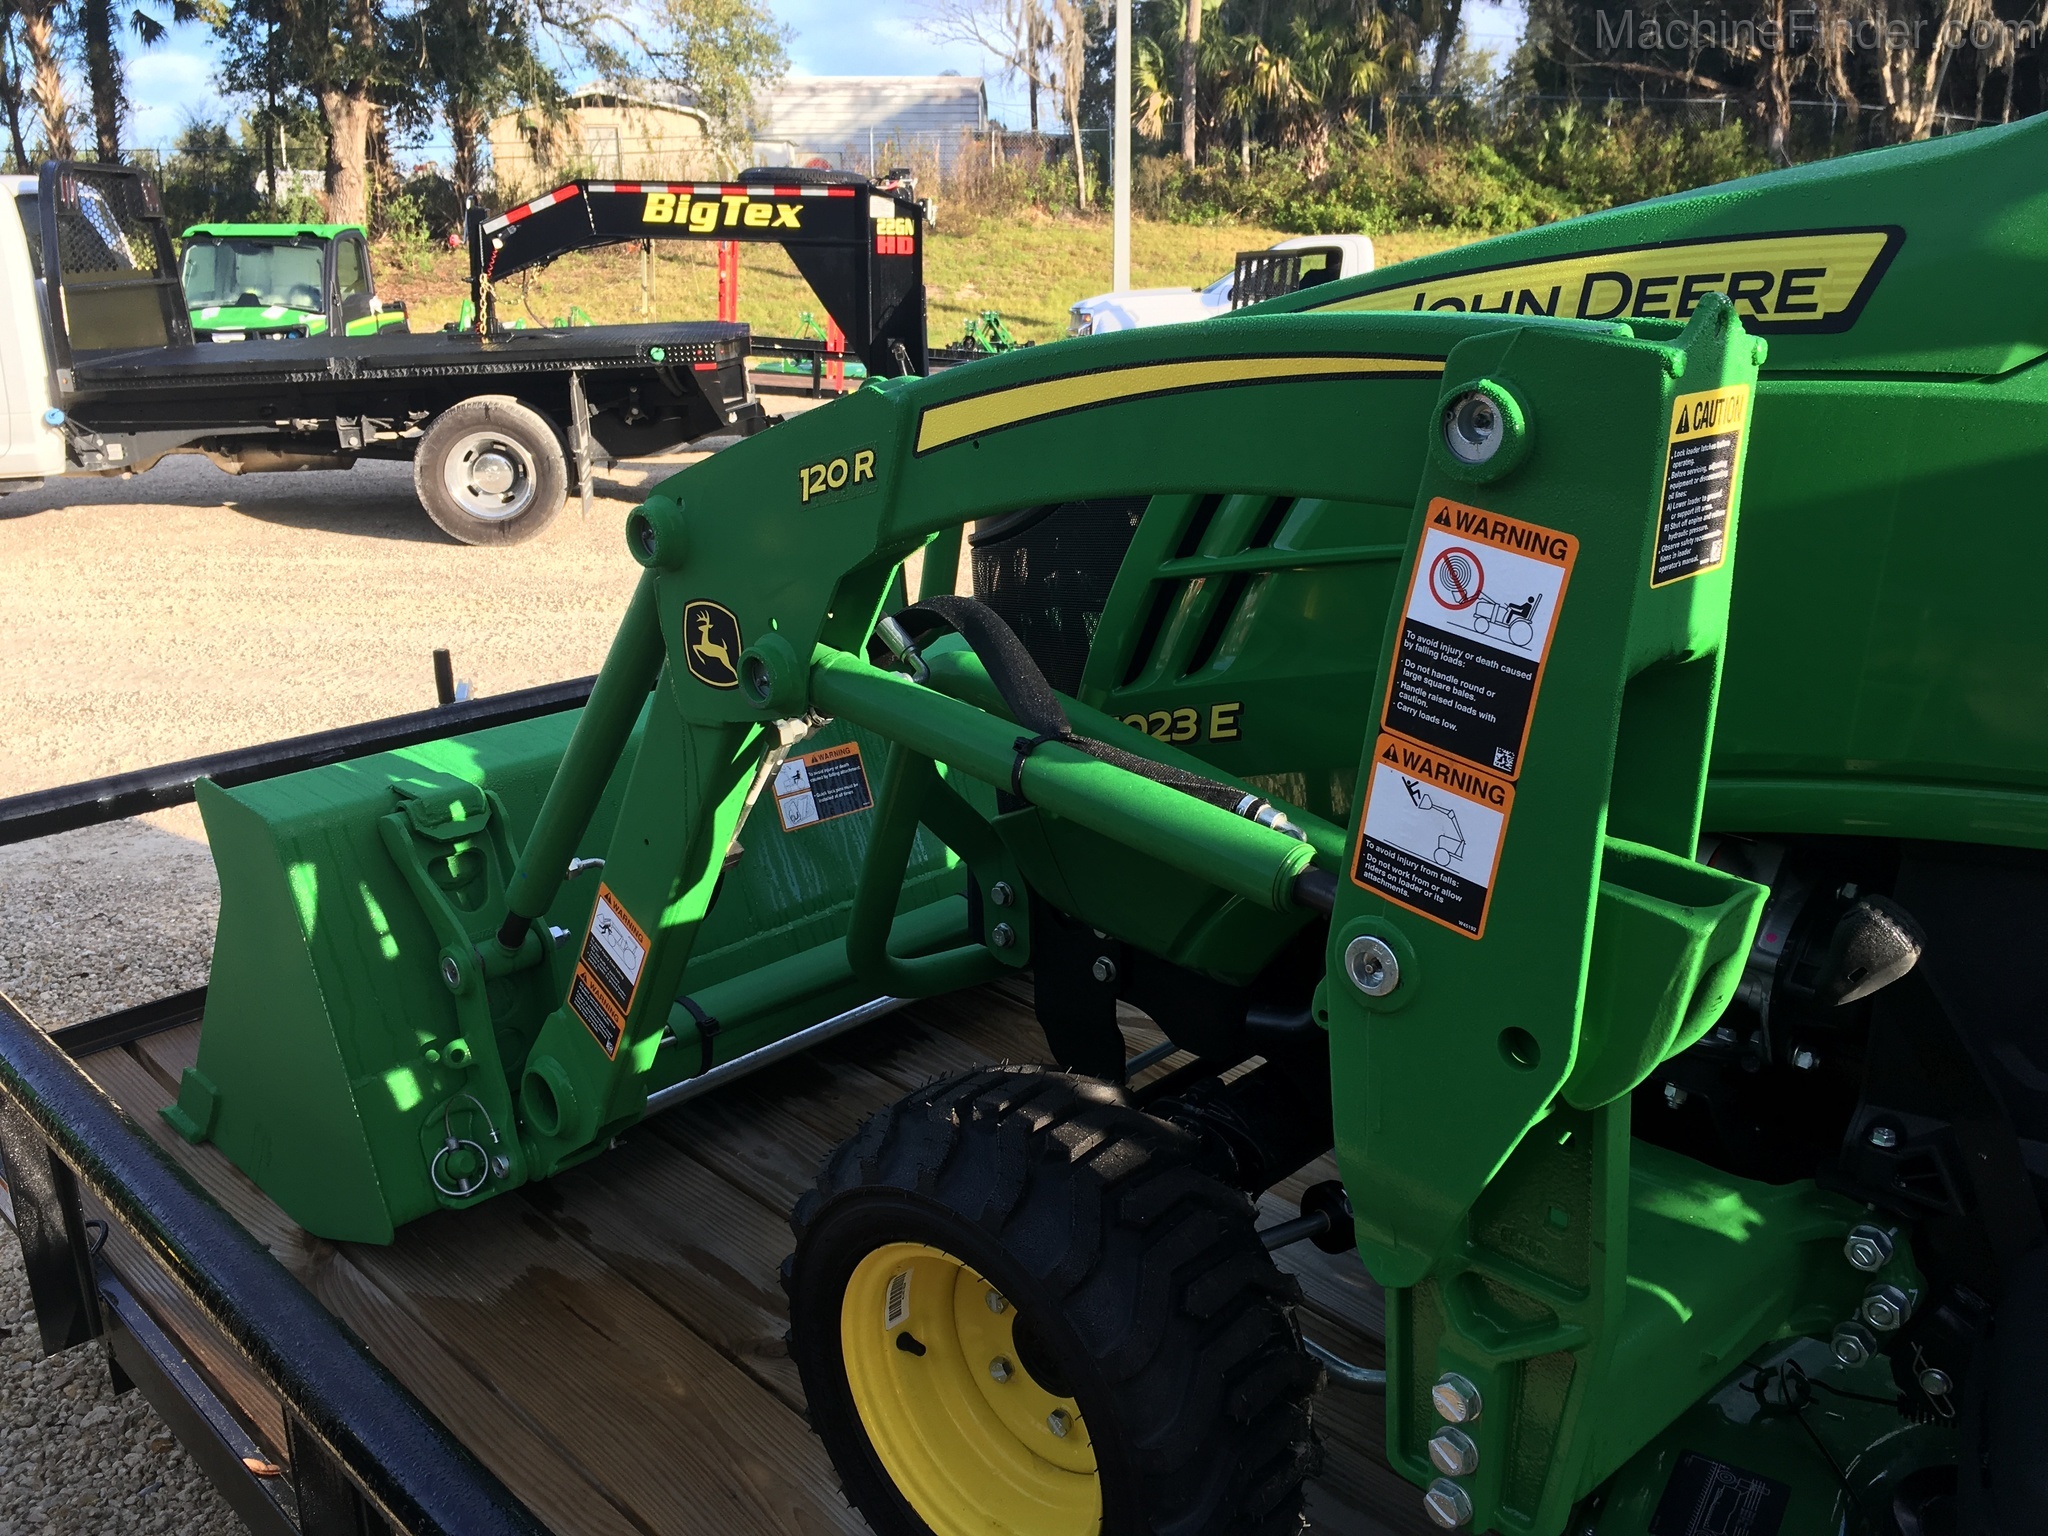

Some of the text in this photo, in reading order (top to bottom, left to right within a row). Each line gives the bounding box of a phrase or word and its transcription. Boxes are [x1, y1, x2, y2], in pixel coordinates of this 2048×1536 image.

[642, 192, 804, 232] BigTex
[876, 217, 915, 236] 22GN
[876, 235, 914, 255] HD
[1576, 267, 1827, 320] DEERE
[1693, 394, 1744, 431] CAUTION
[800, 449, 875, 502] 120 R
[1456, 510, 1568, 561] WARNING
[1404, 639, 1466, 668] by falling loads:
[1406, 630, 1533, 681] To avoid injury or death caused
[1403, 668, 1476, 701] large square bales.
[1405, 658, 1496, 698] Do not handle round or
[1397, 701, 1458, 732] Carry loads low.
[1398, 691, 1429, 709] caution.
[1400, 681, 1497, 723] Handle raised loads with
[1111, 702, 1240, 743] 023 E
[817, 747, 851, 760] WARNING
[1403, 748, 1506, 806] WARNING
[1365, 839, 1460, 888] To avoid injury from falls:
[1365, 862, 1444, 904] riders on loader or its
[1367, 853, 1463, 902] Do not work from or allow
[1363, 871, 1410, 898] attachments.
[611, 900, 645, 943] WARNING
[589, 981, 620, 1023] WARNING
